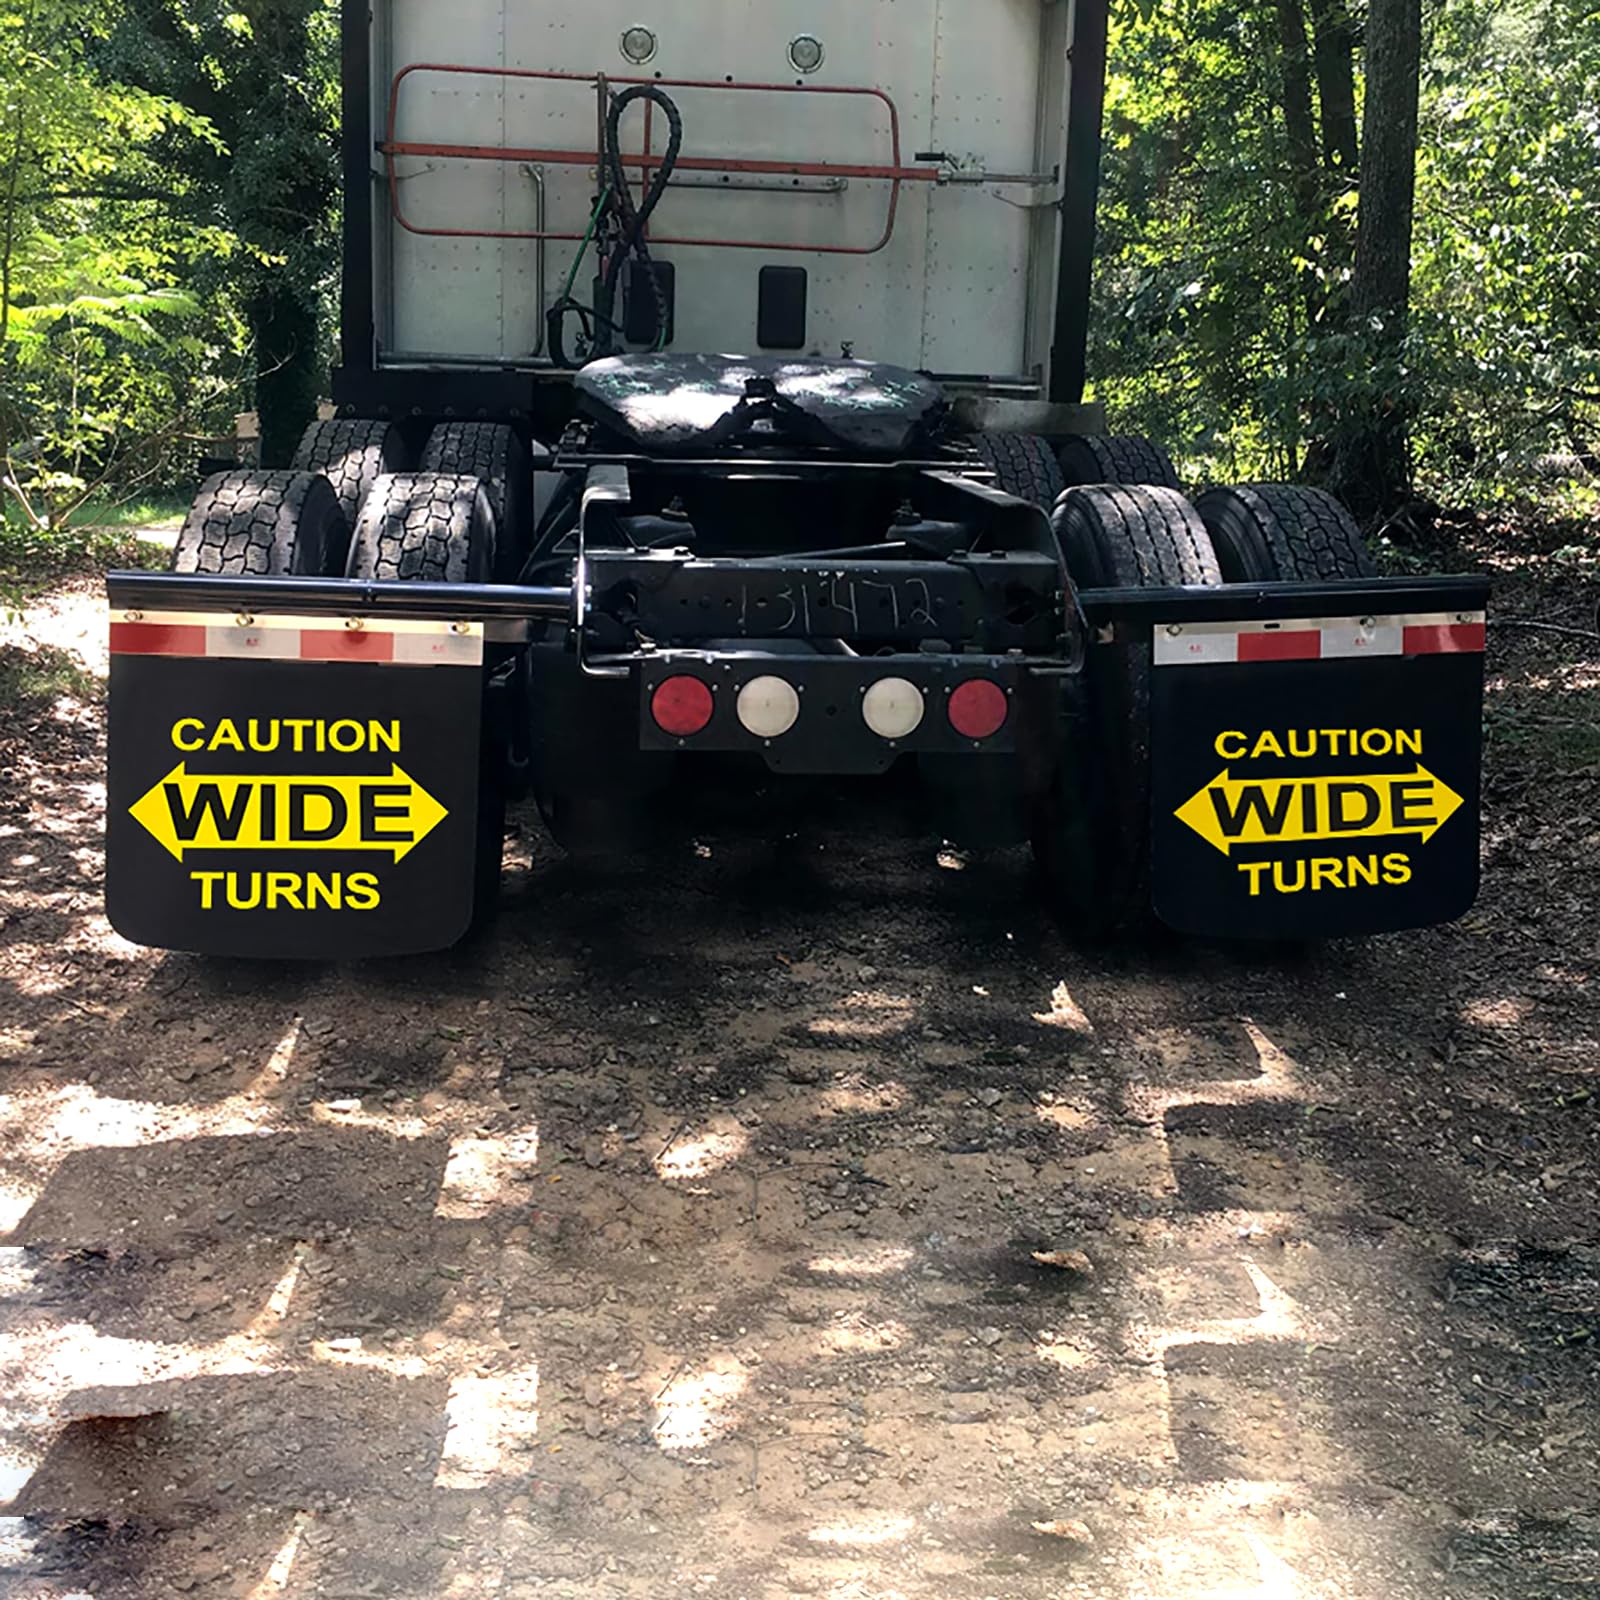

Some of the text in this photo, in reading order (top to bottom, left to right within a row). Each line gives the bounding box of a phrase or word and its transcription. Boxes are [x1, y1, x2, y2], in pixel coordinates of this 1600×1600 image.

[738, 577, 938, 634] 131472
[171, 717, 401, 754] CAUTION
[1214, 728, 1422, 759] CAUTION
[163, 783, 414, 842] WIDE
[1208, 780, 1438, 837] WIDE
[190, 871, 381, 910] TURNS
[1237, 852, 1412, 896] TURNS
